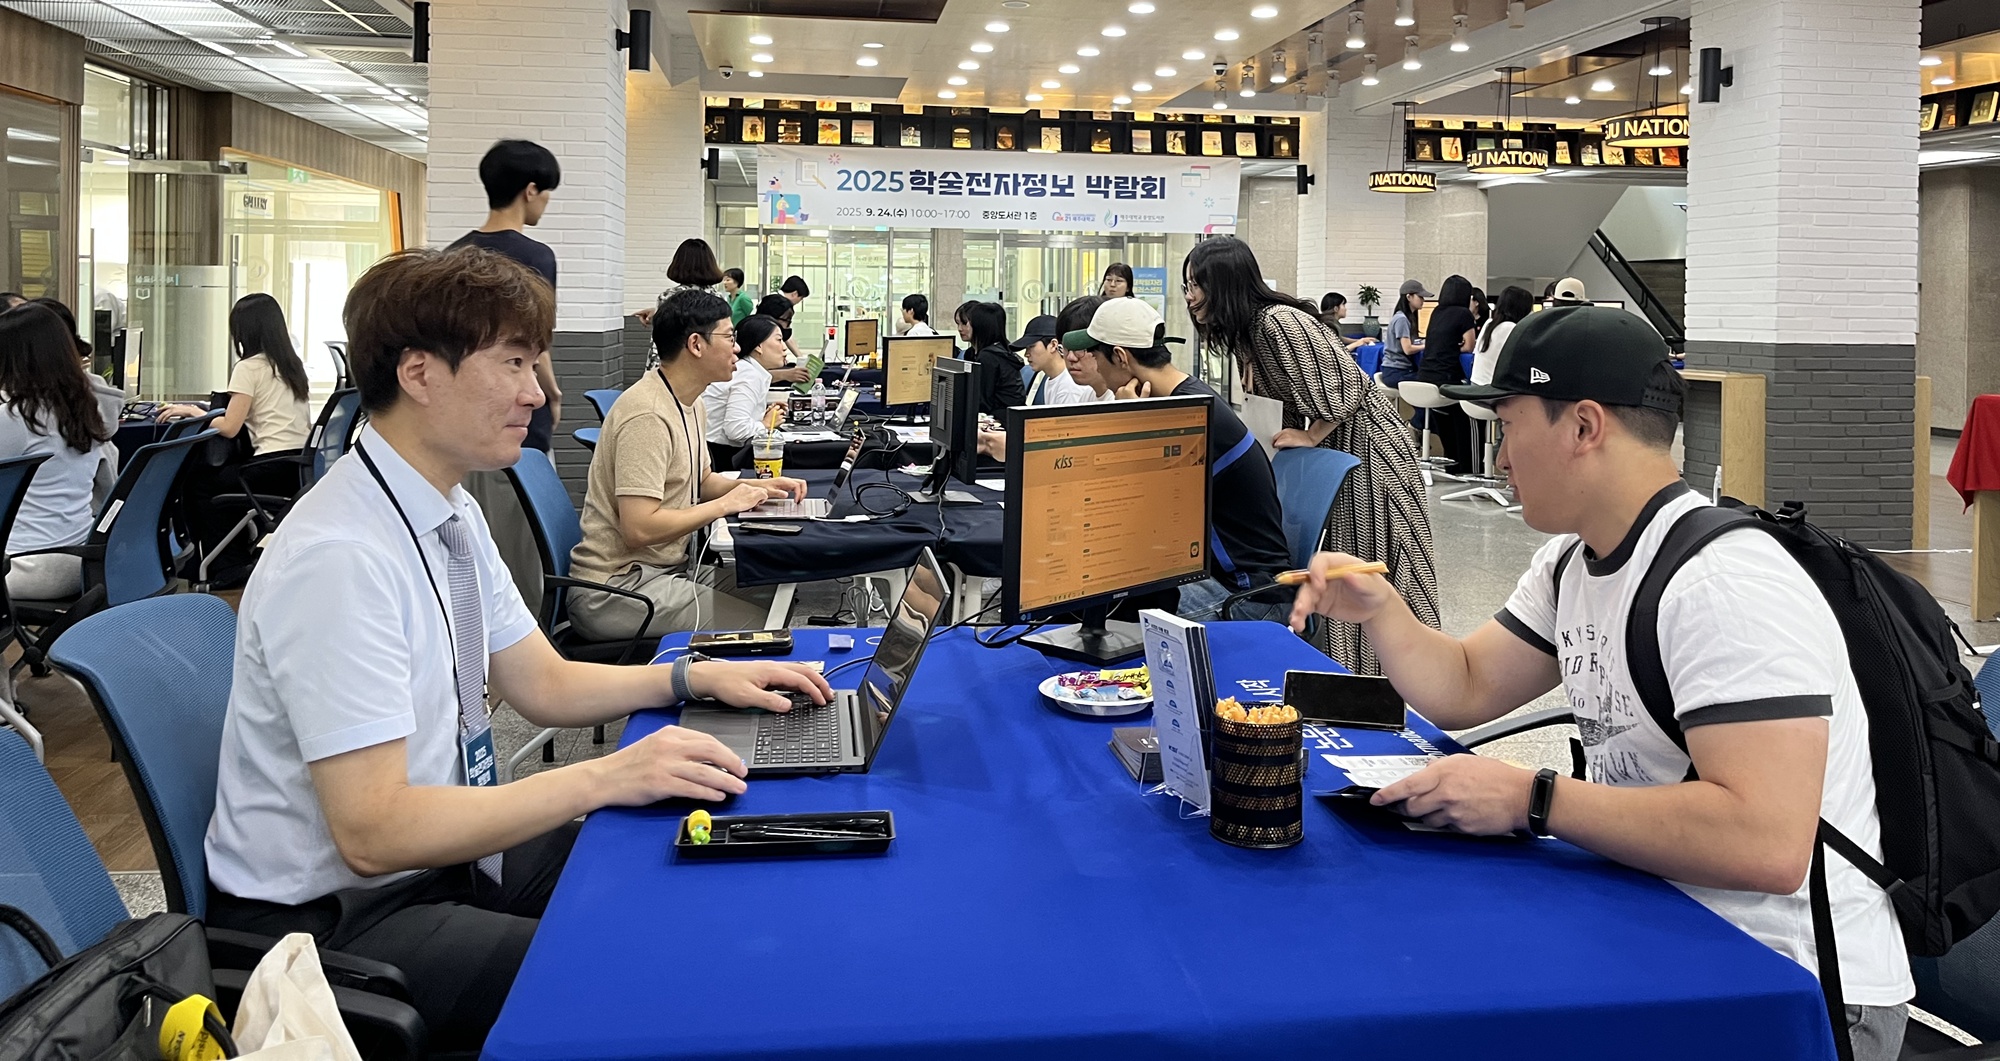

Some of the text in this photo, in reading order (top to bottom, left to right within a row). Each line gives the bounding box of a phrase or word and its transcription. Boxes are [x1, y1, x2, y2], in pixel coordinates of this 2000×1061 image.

[836, 169, 1166, 200] 2025 학술전자정보 박람회
[1374, 172, 1434, 187] NATIONAL
[836, 207, 971, 219] 2025. 9. 24.(수) 10:00~17:00
[982, 210, 1022, 221] 중앙도서관
